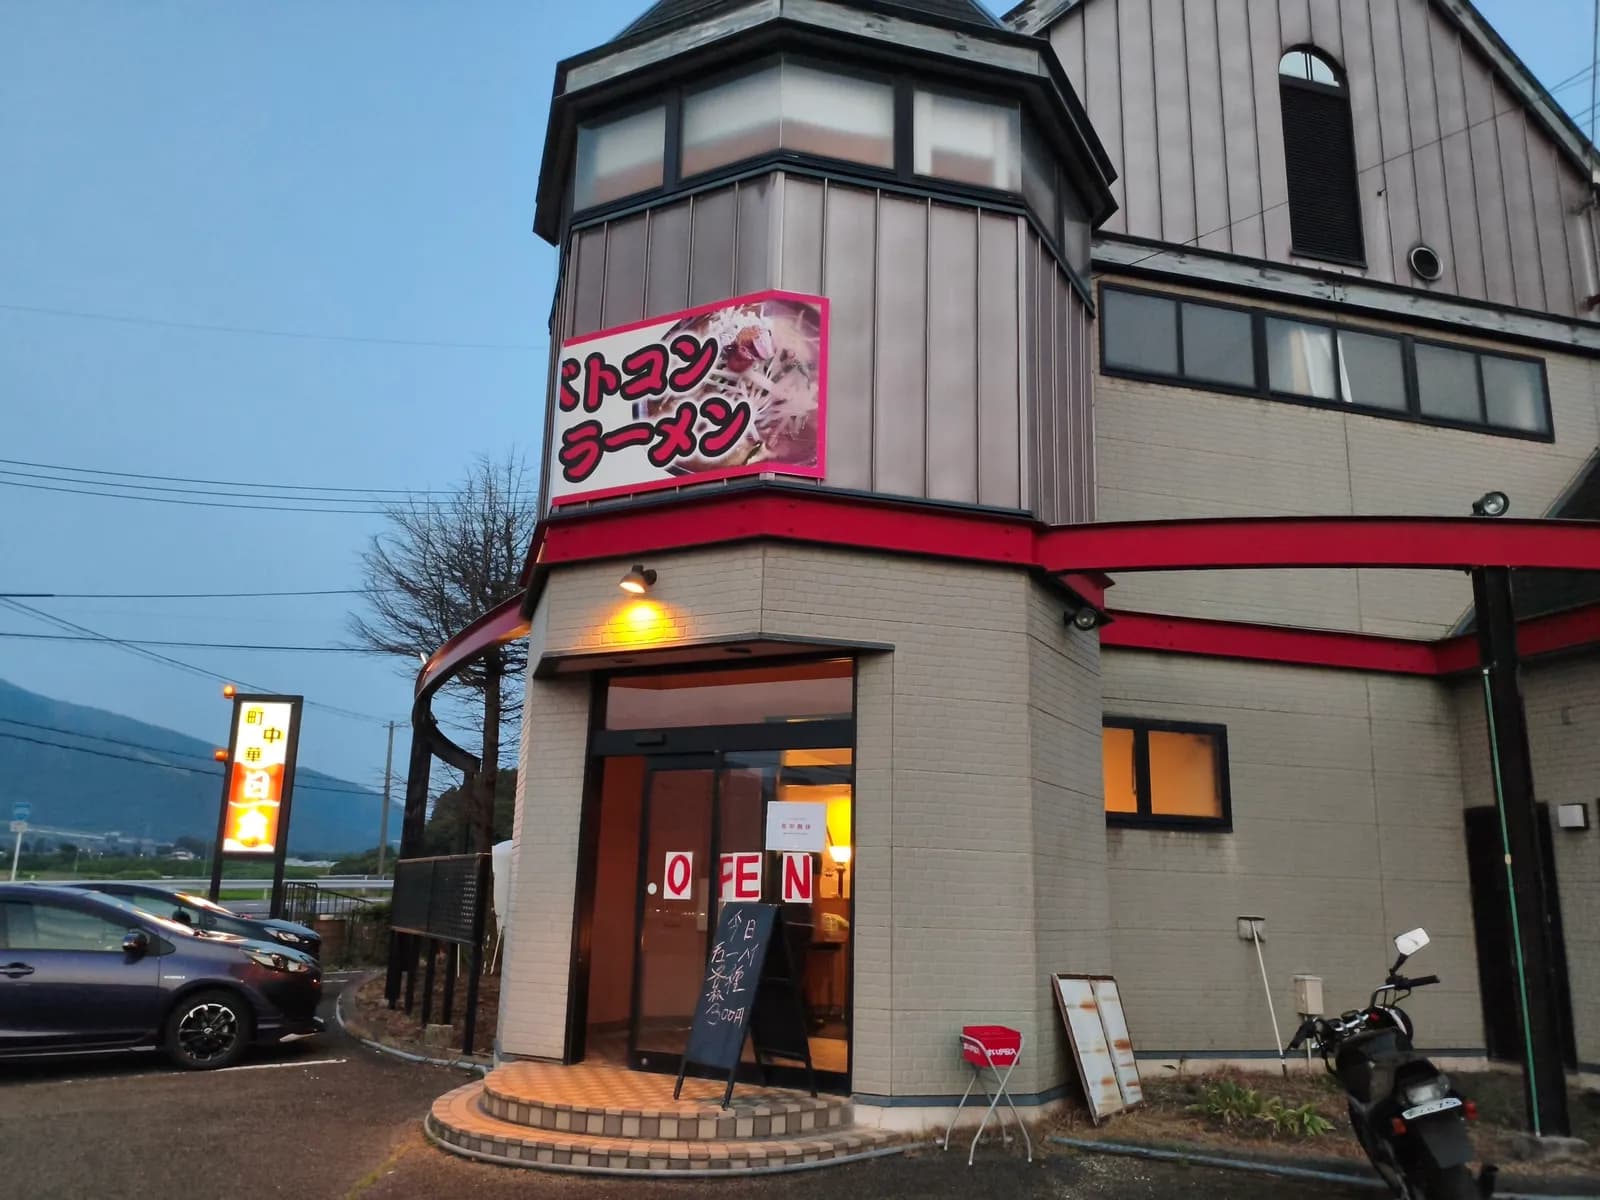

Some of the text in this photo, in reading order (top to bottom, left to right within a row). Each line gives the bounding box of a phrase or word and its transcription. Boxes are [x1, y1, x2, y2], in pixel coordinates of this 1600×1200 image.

[558, 397, 751, 483] ラーメン
[246, 709, 281, 762] 町中華
[727, 909, 756, 942] 今日
